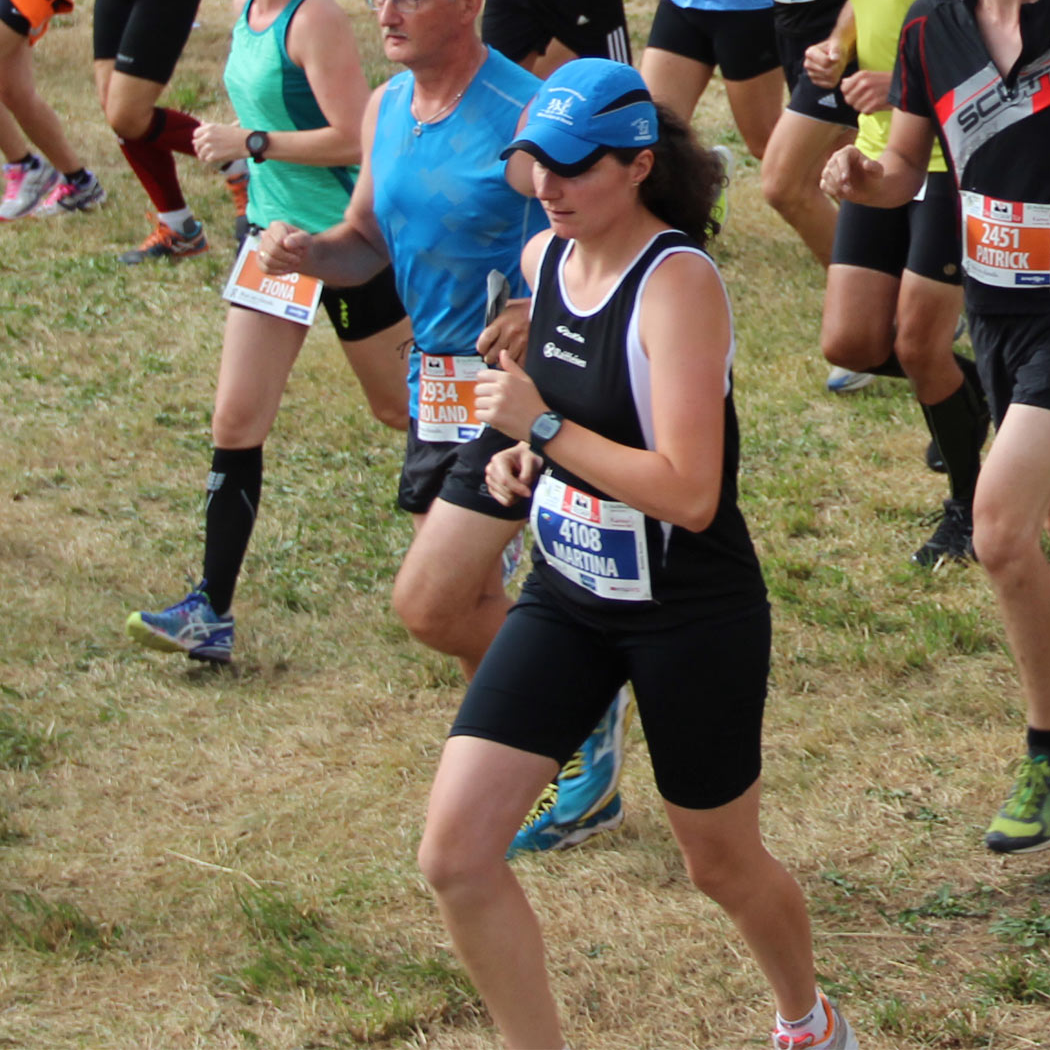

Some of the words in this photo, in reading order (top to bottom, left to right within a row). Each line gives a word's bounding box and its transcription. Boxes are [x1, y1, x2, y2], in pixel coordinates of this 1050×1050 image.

[981, 223, 1020, 249] 2451
[976, 244, 1030, 270] PATRICK
[258, 277, 296, 302] FIONA
[421, 381, 459, 403] 2934
[420, 403, 469, 423] OLAND
[559, 518, 603, 552] 4108
[552, 540, 619, 578] MARTINA
